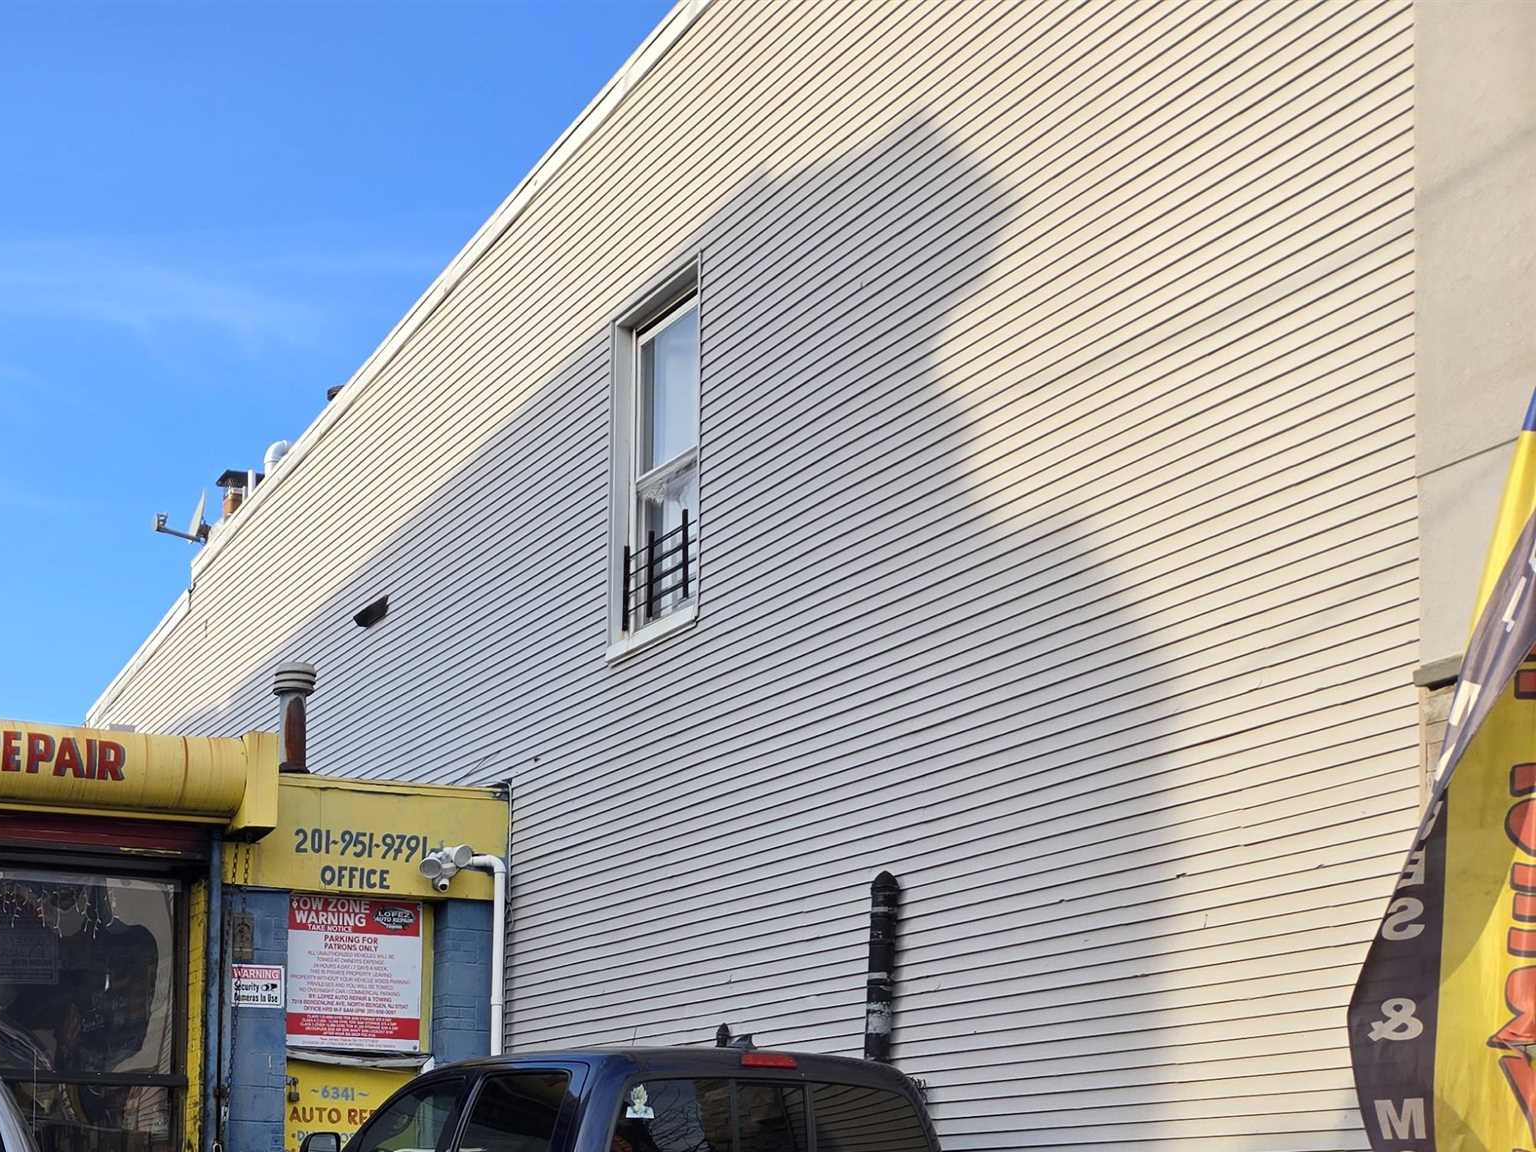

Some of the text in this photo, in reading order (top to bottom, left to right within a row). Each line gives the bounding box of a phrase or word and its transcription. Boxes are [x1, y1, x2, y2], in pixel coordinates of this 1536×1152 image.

[294, 828, 428, 863] 201-951-9791
[320, 864, 390, 889] OFFICE
[327, 898, 370, 913] ZONE
[295, 910, 366, 927] WARNING
[307, 924, 325, 932] TAKE
[324, 934, 378, 945] PARKING FOR
[324, 943, 378, 952] PATRONS ONLY
[233, 968, 280, 979] WARNING
[321, 1087, 356, 1101] 6341
[288, 1106, 342, 1124] AUTO
